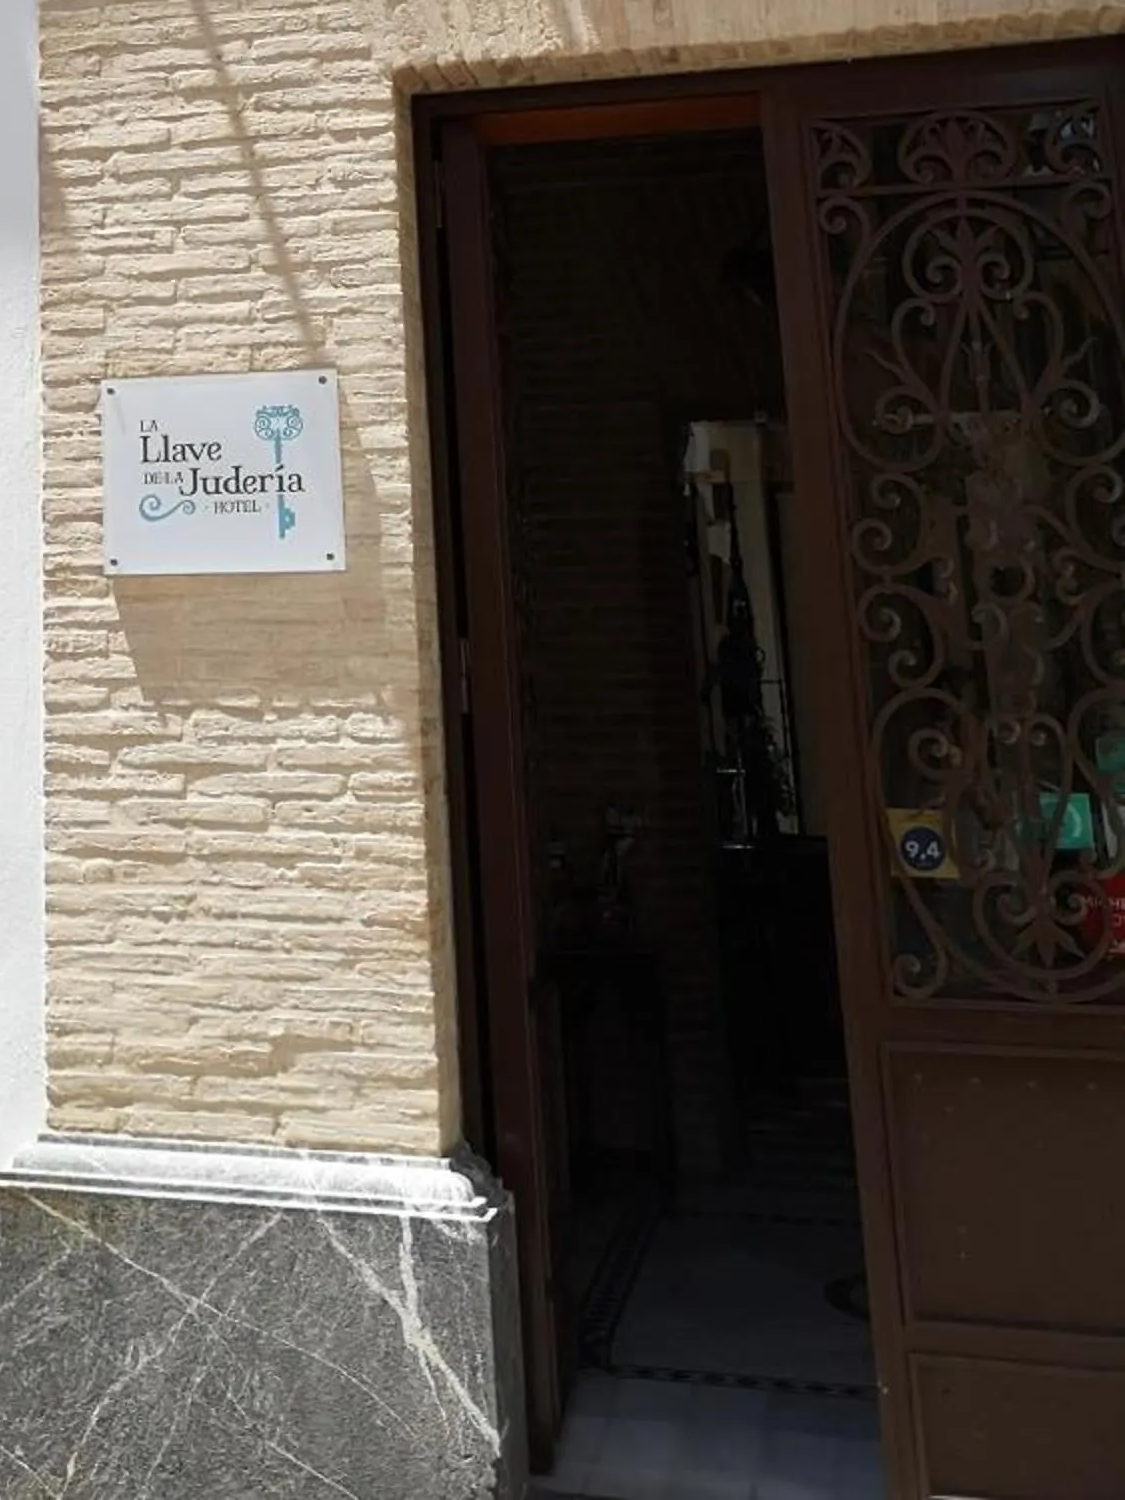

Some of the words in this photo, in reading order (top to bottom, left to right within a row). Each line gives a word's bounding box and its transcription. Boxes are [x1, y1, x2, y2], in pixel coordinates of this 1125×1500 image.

[140, 419, 158, 432] LA
[139, 434, 221, 462] Llave
[179, 465, 305, 495] Judería
[214, 499, 262, 514] HOTEL
